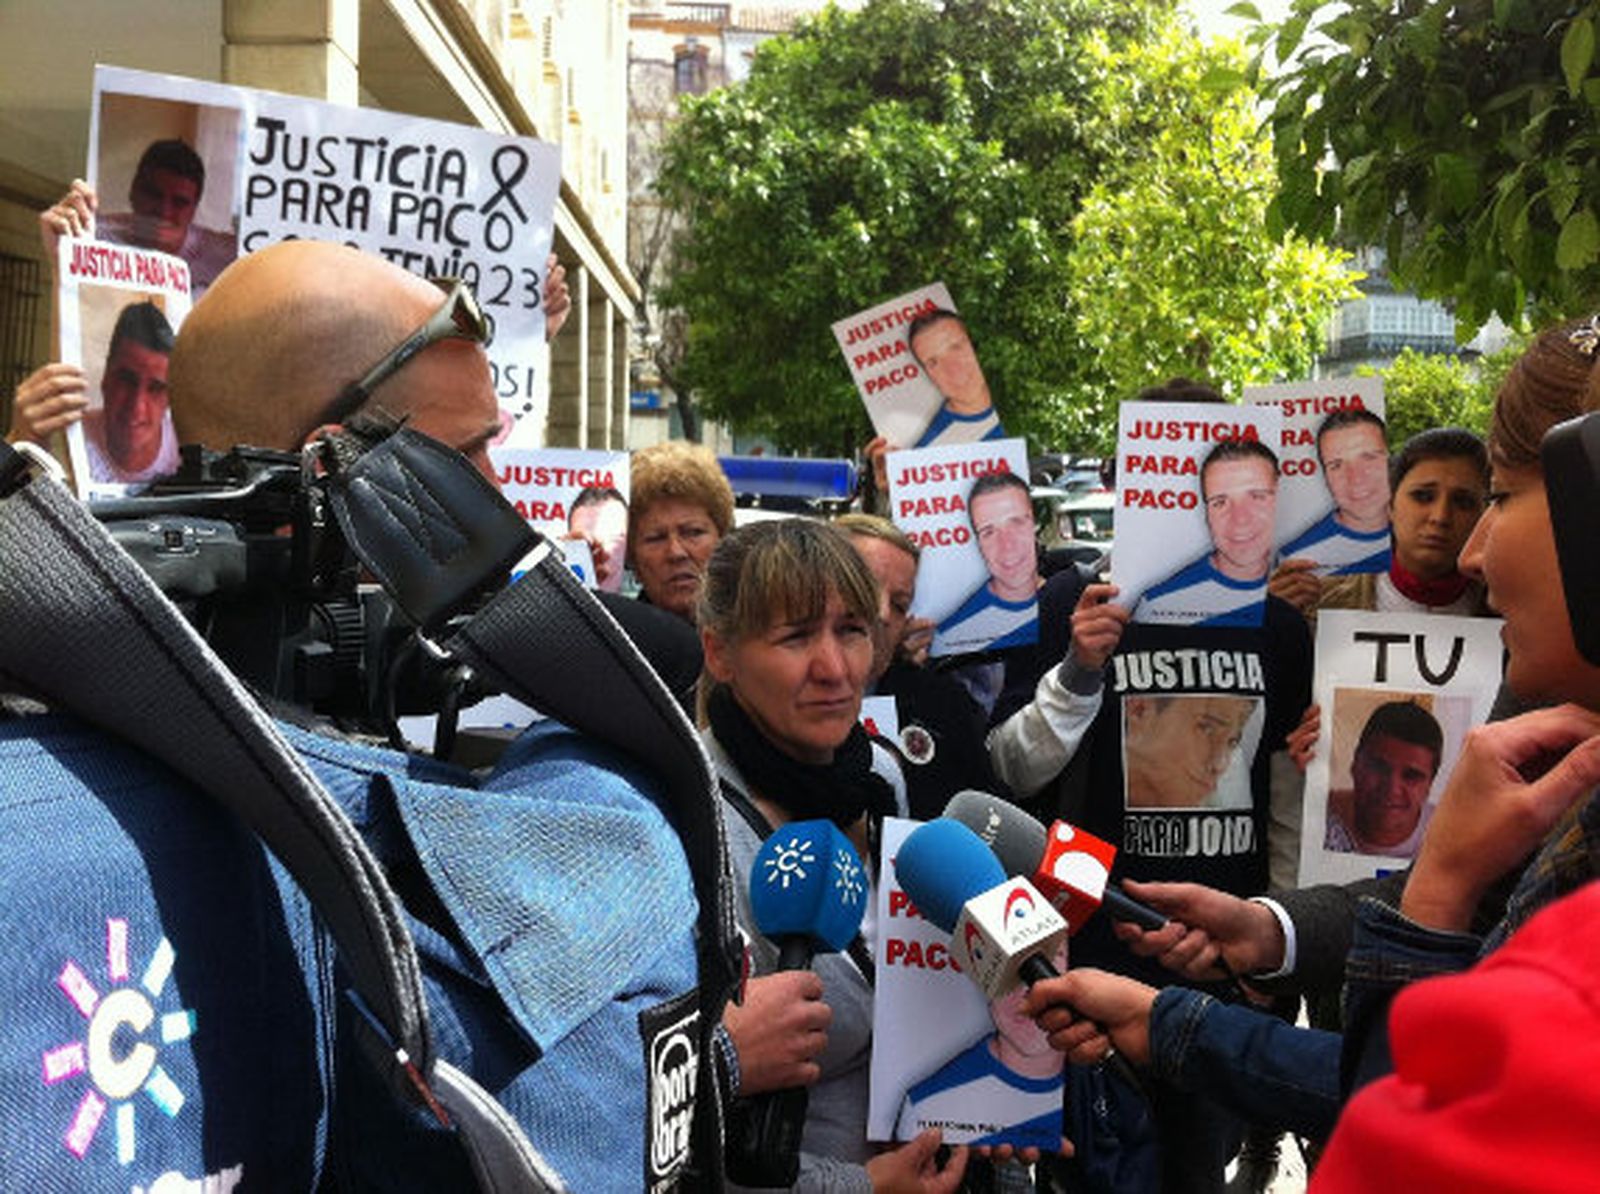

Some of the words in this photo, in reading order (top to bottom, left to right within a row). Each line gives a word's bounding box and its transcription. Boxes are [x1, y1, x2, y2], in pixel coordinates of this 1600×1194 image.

[245, 174, 371, 232] PARA
[388, 191, 513, 252] PACO
[69, 243, 132, 281] JUSTICIA
[486, 264, 541, 309] 23
[846, 297, 938, 345] JUSTICIA
[853, 340, 907, 370] PARA
[864, 363, 919, 395] PACO
[1256, 394, 1367, 418] STICIA
[1127, 420, 1260, 443] JUSTICIA
[1280, 429, 1315, 447] RA
[497, 466, 616, 489] JUSTICIA
[896, 457, 1011, 487] JUSTICIA
[1125, 455, 1198, 476] PARA
[1281, 458, 1318, 476] CO
[513, 499, 566, 521] ARA
[900, 494, 966, 518] PARA
[1123, 488, 1198, 511] PACO
[1113, 649, 1266, 692] JUSTICIA
[1353, 631, 1465, 686] TU
